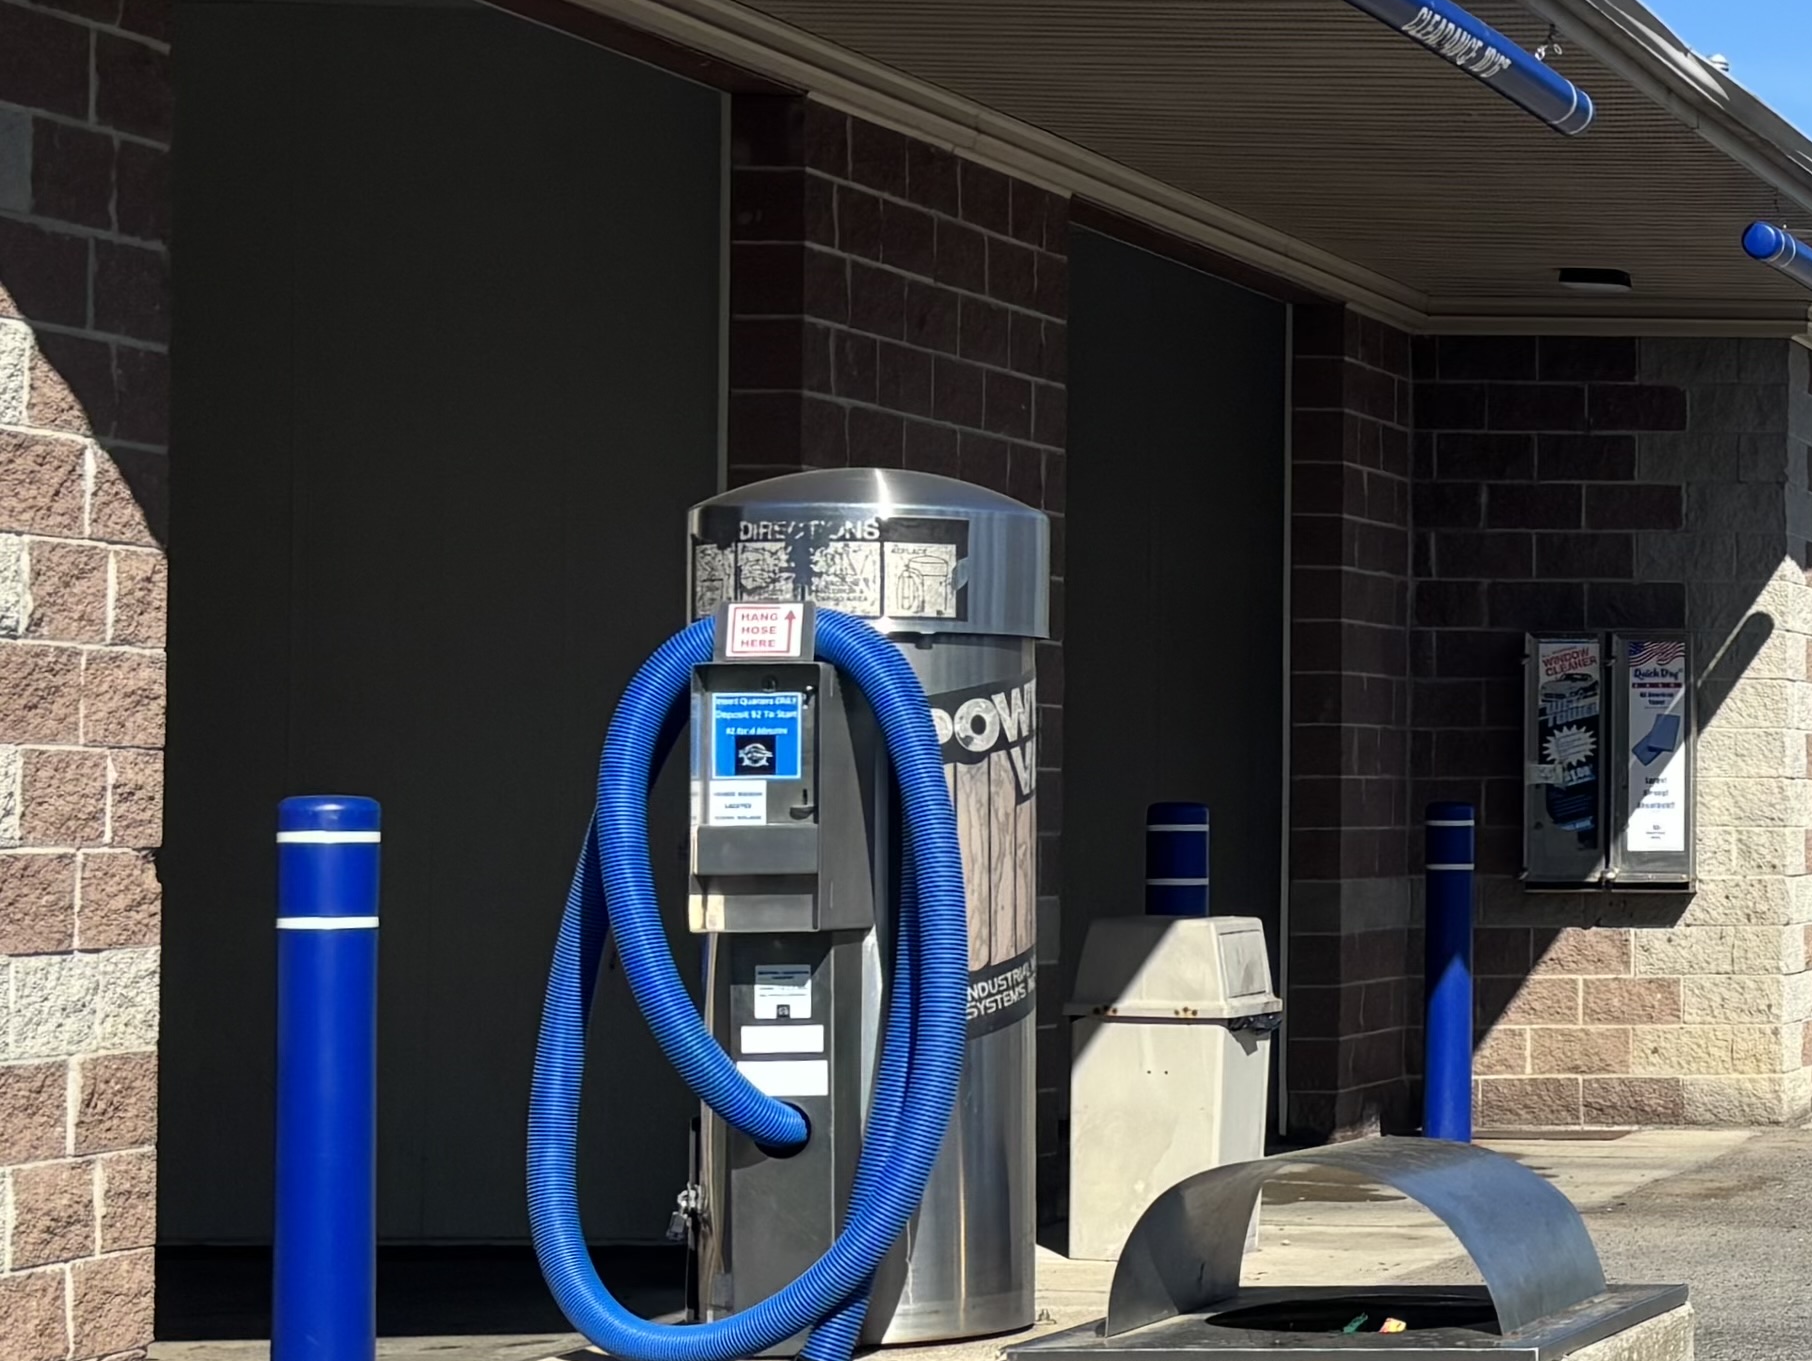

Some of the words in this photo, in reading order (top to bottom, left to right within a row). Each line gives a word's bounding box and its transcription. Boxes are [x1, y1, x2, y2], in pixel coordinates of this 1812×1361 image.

[739, 519, 881, 540] DIRETNS
[741, 612, 779, 622] HANG
[741, 626, 777, 635] HOSE
[740, 640, 776, 648] HERE
